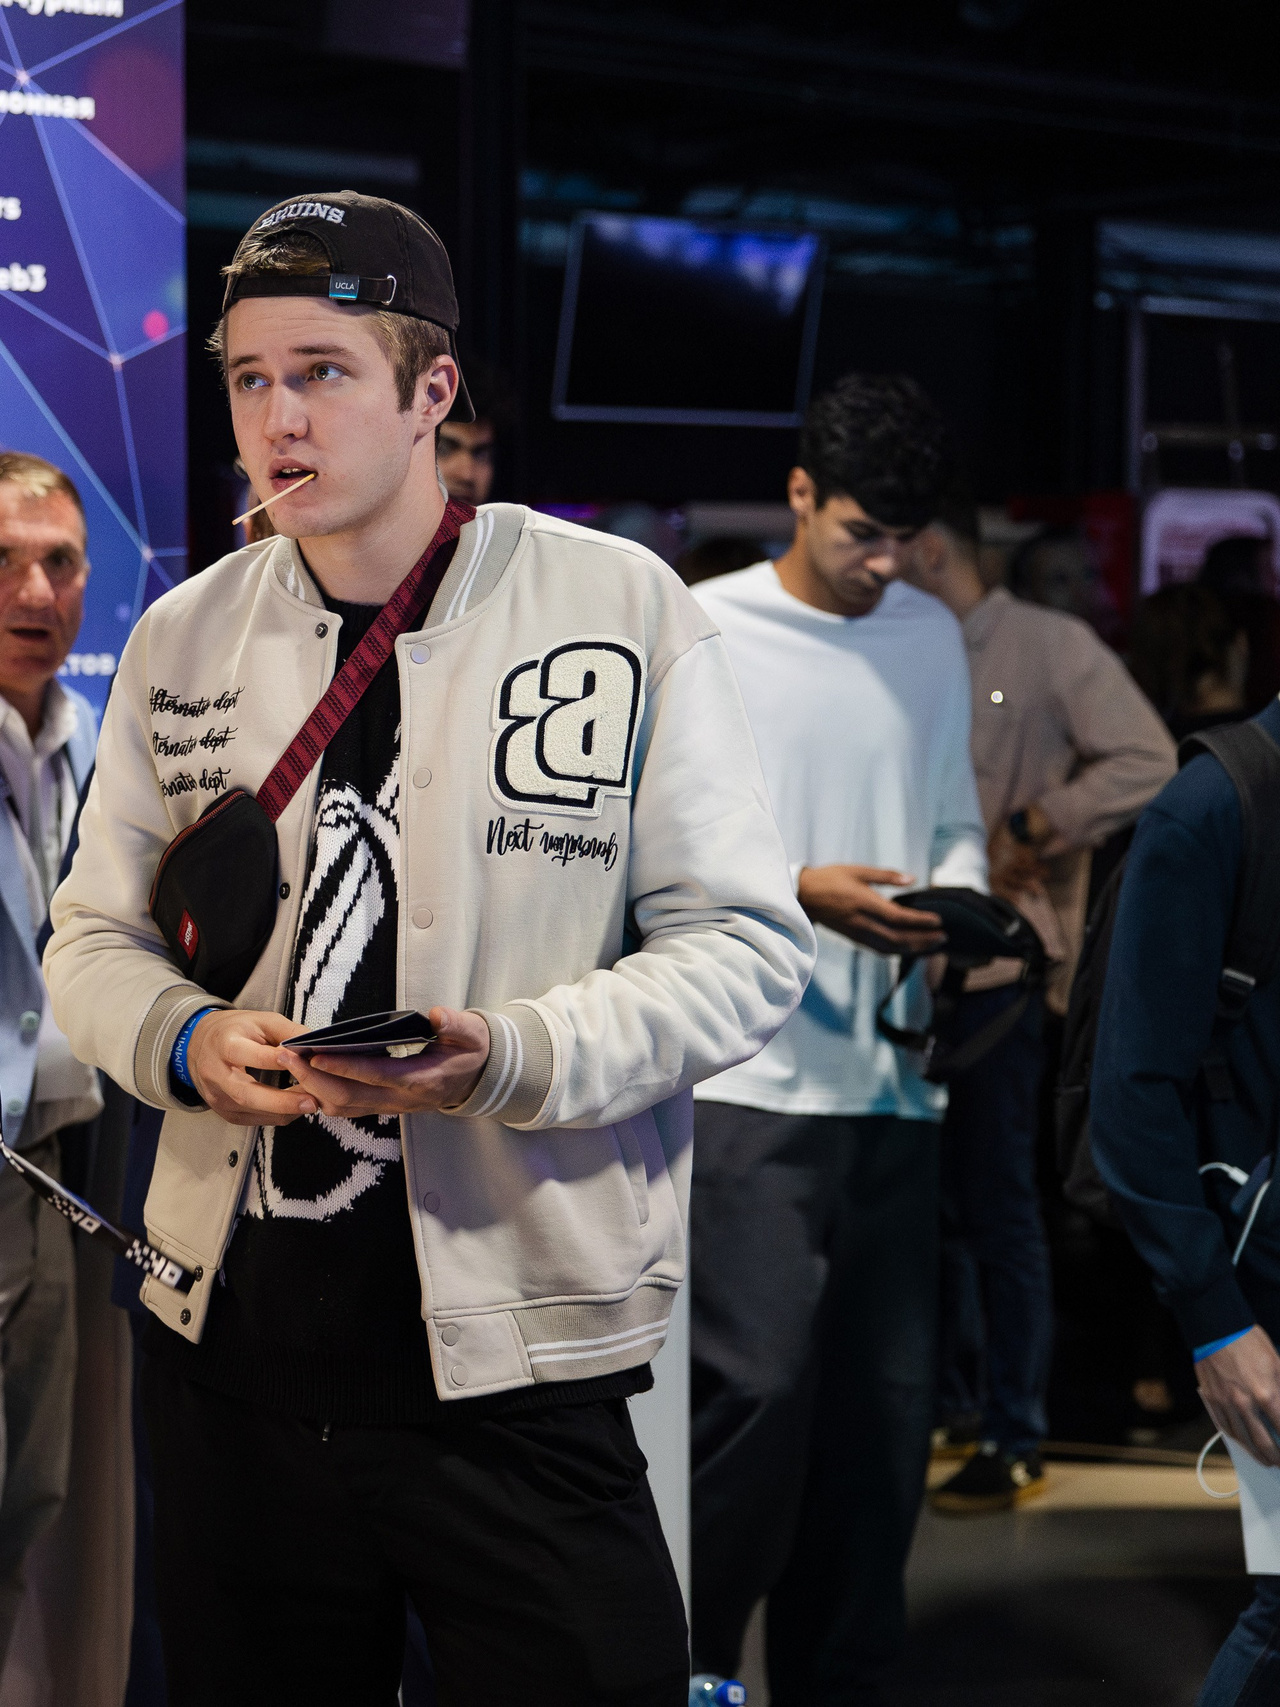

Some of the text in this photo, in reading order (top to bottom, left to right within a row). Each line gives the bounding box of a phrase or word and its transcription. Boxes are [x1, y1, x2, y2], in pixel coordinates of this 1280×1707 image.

[255, 202, 345, 231] BRUINS
[335, 282, 355, 291] UCLA
[486, 816, 544, 855] Next
